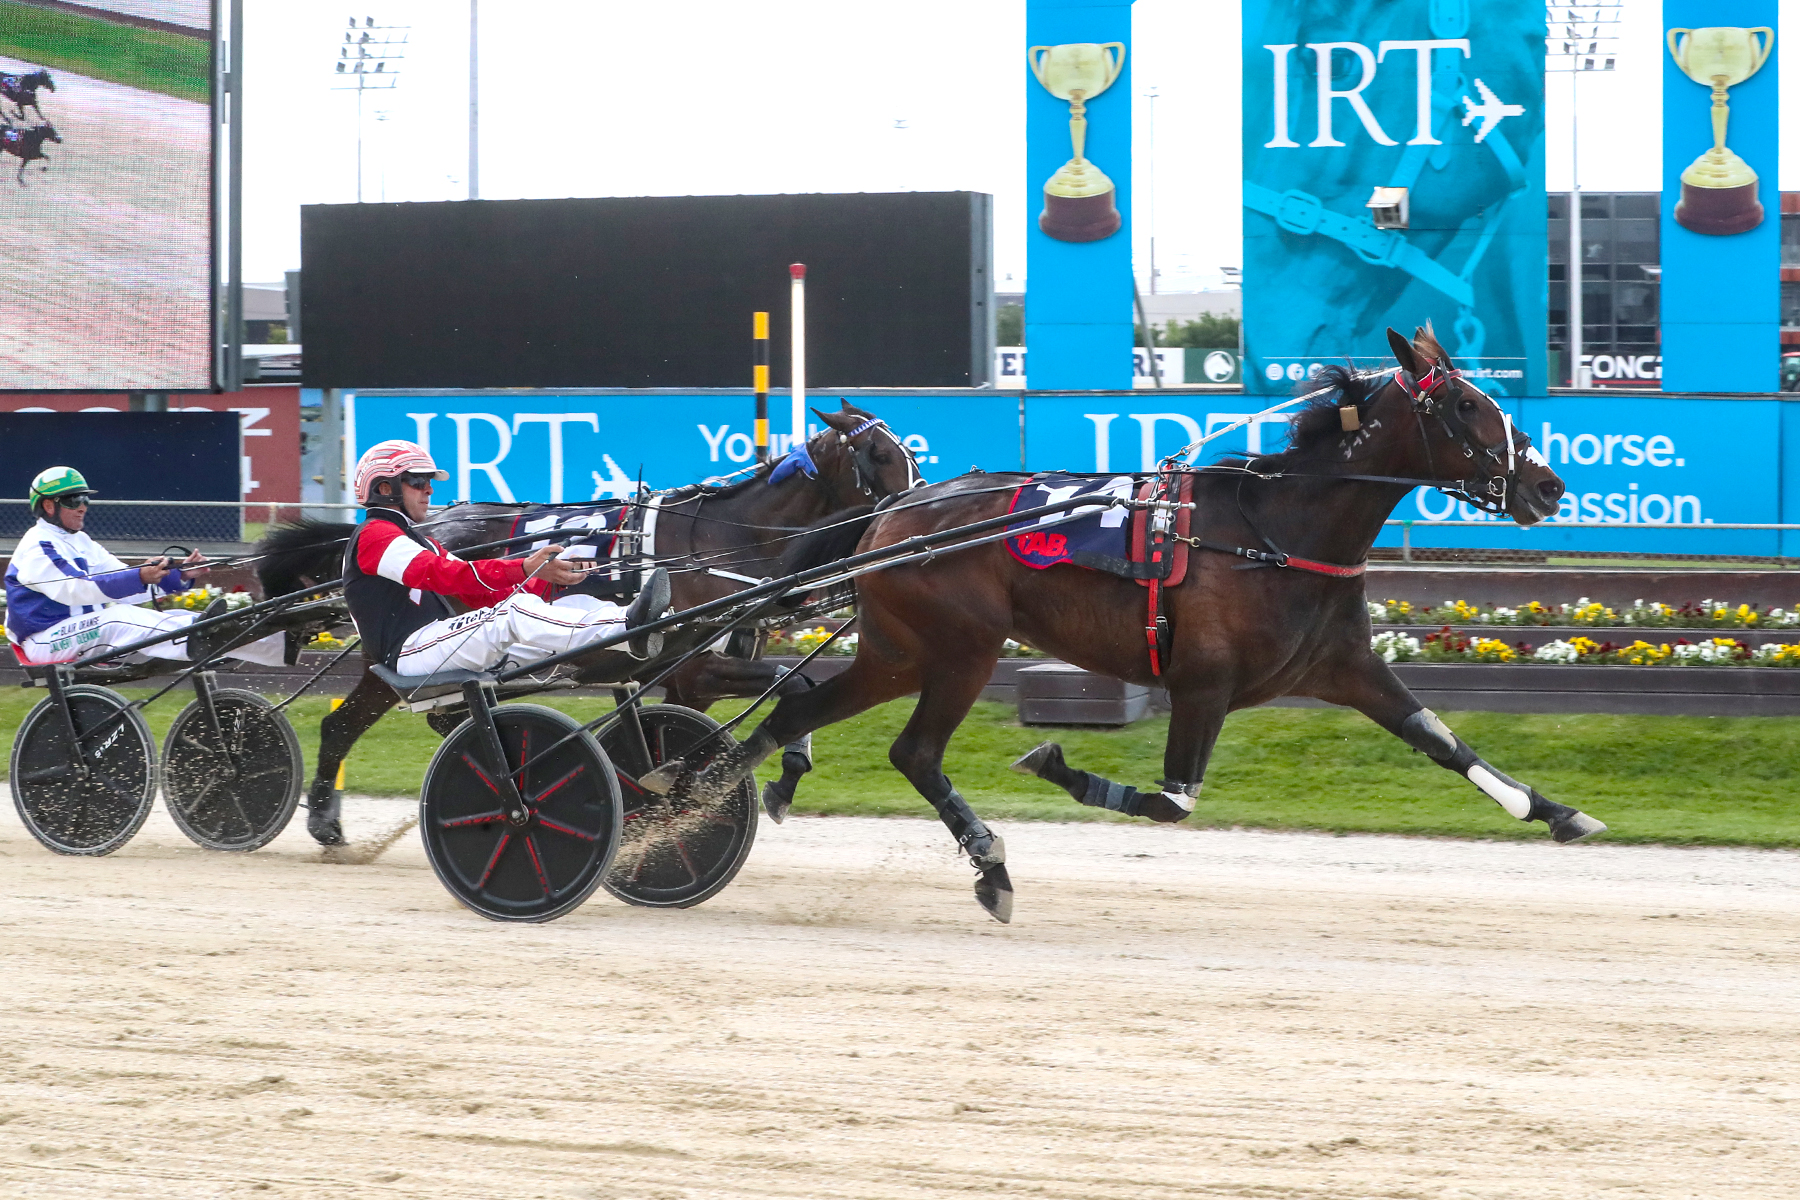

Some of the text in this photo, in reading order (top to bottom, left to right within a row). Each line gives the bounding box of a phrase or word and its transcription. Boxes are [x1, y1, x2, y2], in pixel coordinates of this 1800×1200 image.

[1263, 38, 1471, 148] IRT
[1542, 422, 1685, 467] horse.
[1520, 482, 1714, 530] assion.
